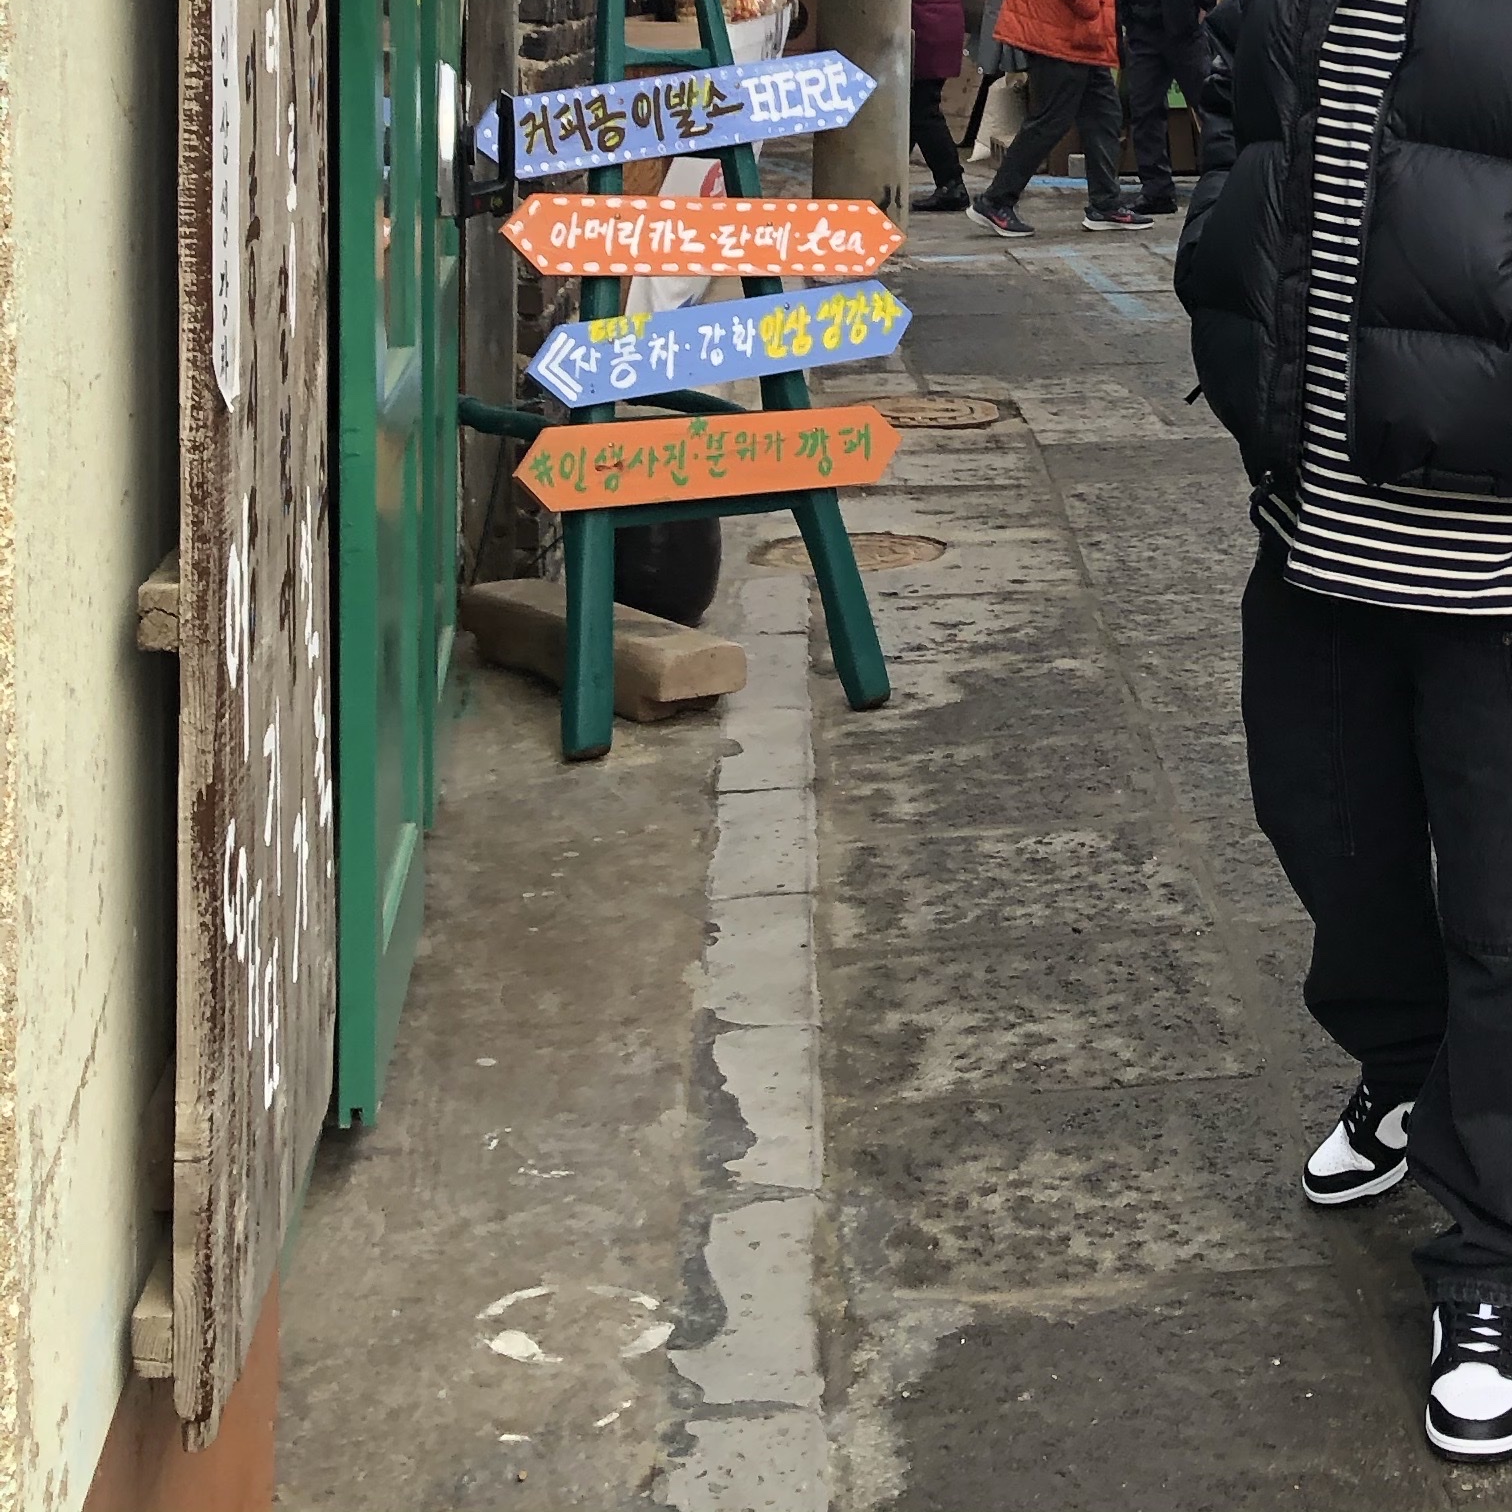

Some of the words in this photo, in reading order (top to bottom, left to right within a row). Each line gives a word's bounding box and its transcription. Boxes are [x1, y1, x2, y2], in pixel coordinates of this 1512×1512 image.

[519, 93, 627, 155] 커피콩
[630, 77, 744, 142] 이발소
[740, 61, 856, 123] HERE
[223, 817, 280, 1112] COFFEE
